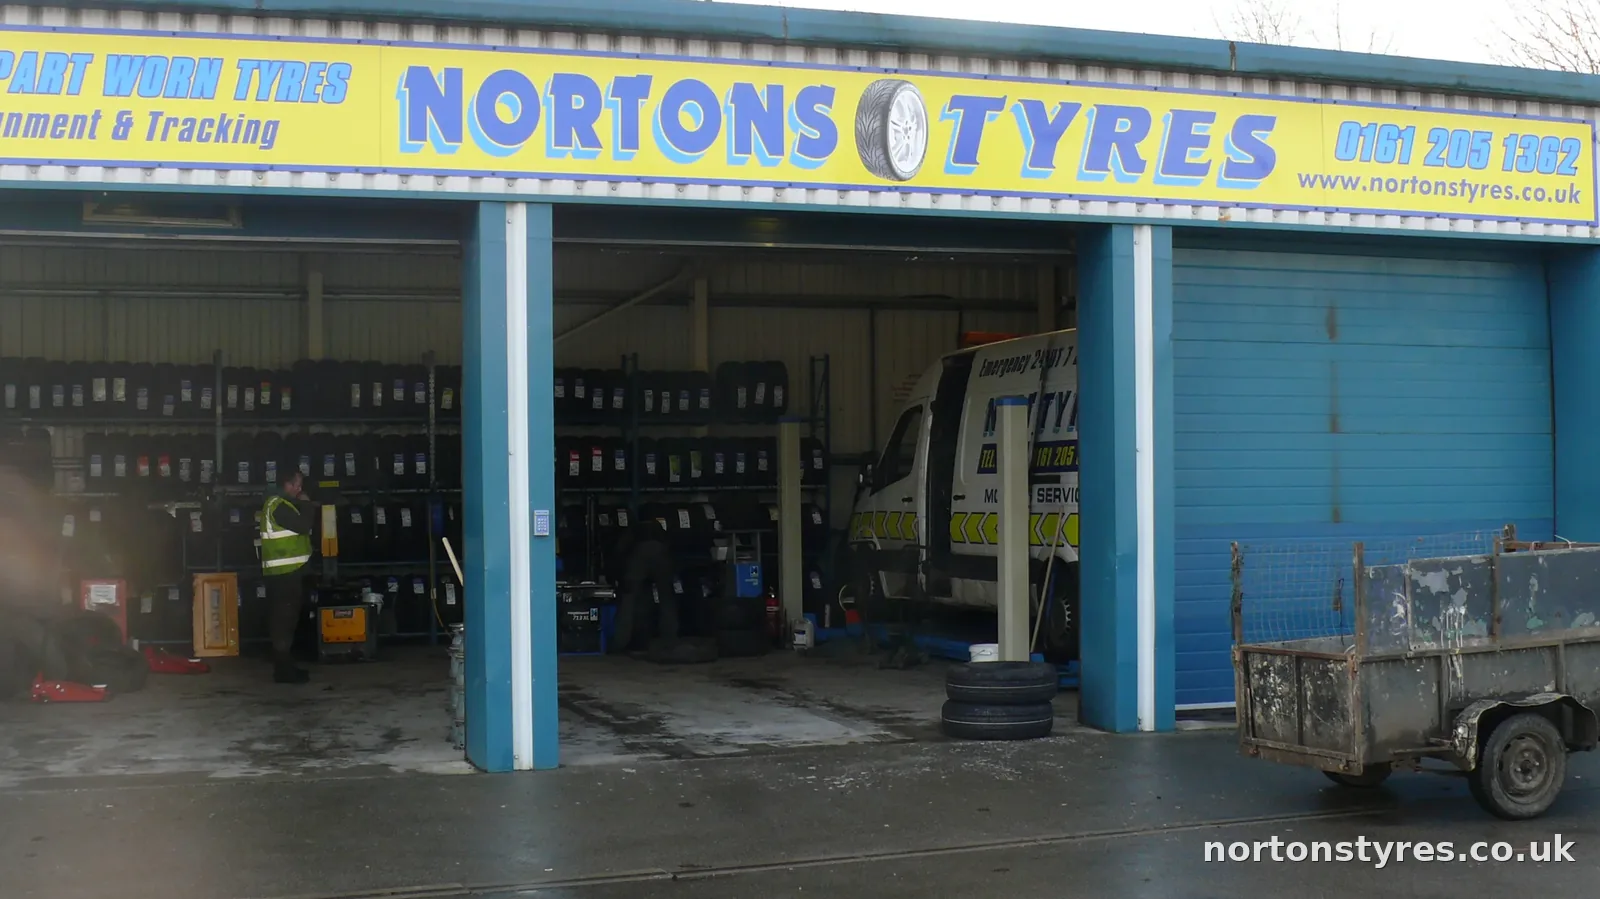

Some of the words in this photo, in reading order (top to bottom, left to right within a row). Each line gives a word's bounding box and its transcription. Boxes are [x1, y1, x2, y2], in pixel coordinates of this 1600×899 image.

[102, 54, 223, 100] WORN
[235, 57, 352, 104] TYRES
[0, 109, 102, 140] nment
[111, 111, 134, 141] &
[148, 110, 280, 150] Tracking
[396, 65, 838, 169] NORTONS
[938, 94, 1277, 190] TYRES
[1334, 120, 1416, 165] 0161
[1423, 127, 1493, 171] 205
[1502, 133, 1581, 176] 1362
[1297, 172, 1581, 204] www.nortonstyres.co.uk
[979, 354, 1031, 378] Emergency
[1053, 445, 1075, 466] 205
